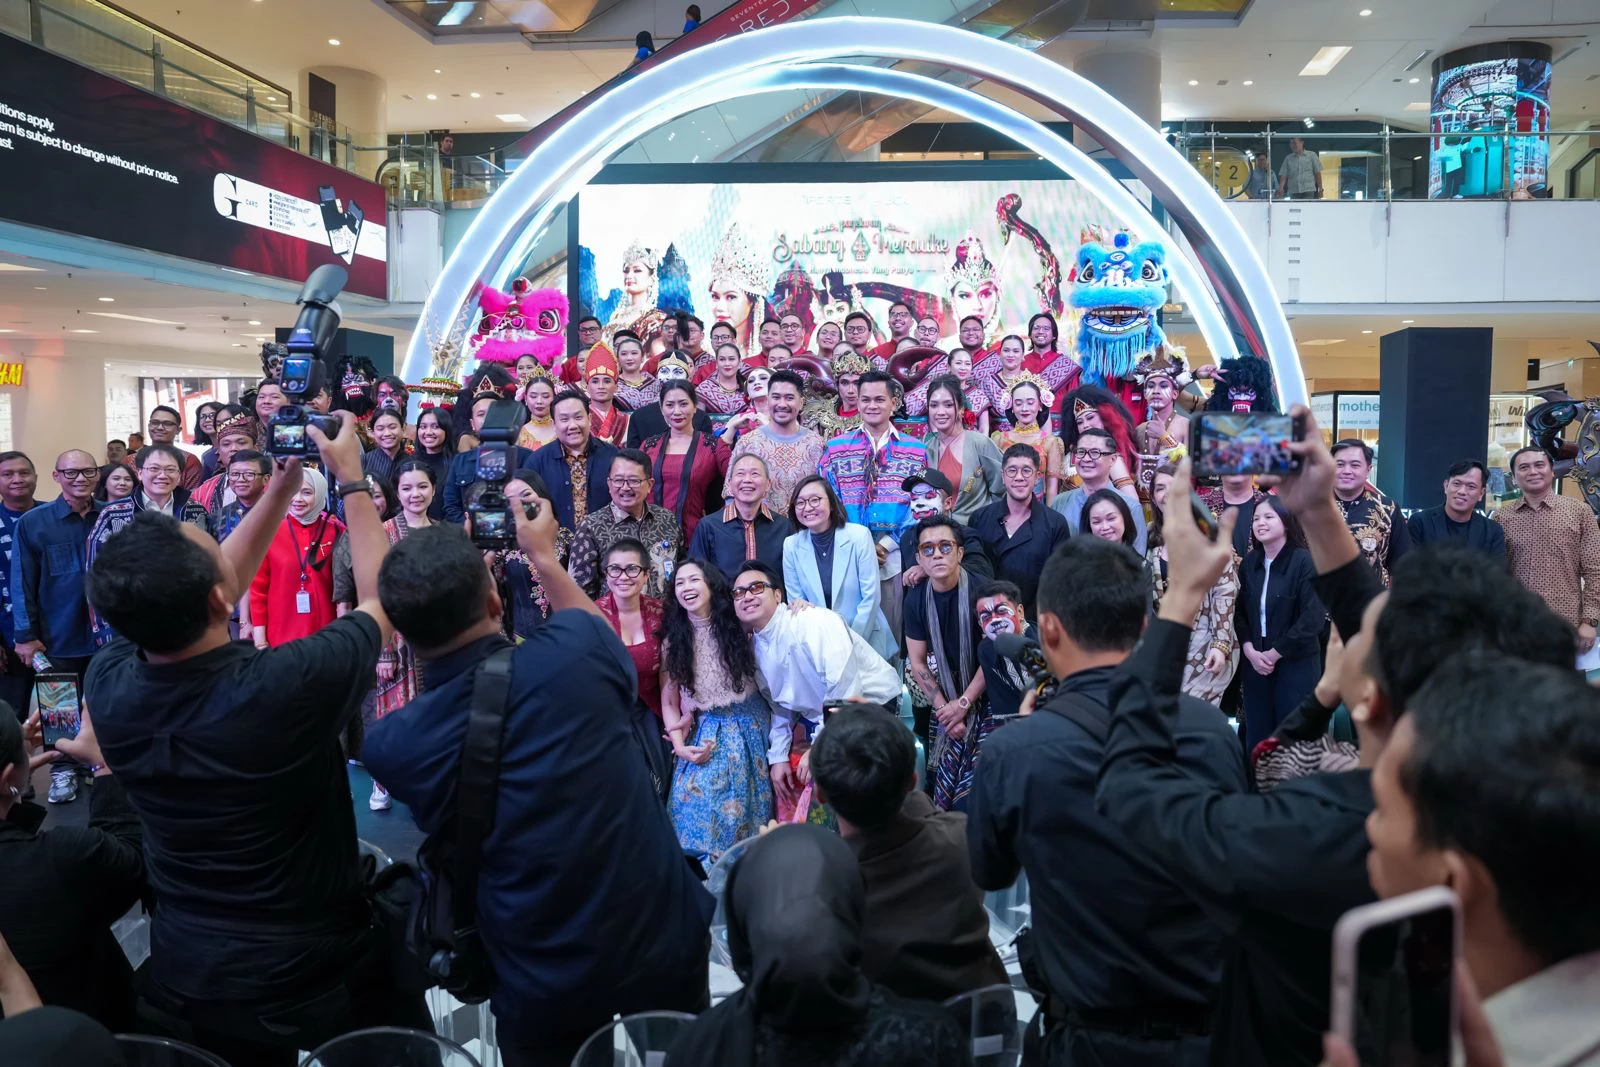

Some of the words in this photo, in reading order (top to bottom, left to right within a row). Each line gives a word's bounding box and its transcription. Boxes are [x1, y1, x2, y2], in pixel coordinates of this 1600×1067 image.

[27, 114, 55, 132] apply.
[16, 124, 25, 137] is
[26, 130, 61, 148] subject
[62, 140, 72, 151] to
[73, 144, 105, 163] change
[105, 154, 136, 172] without
[136, 164, 155, 177] prior
[155, 169, 179, 184] notice.
[1229, 165, 1238, 180] 2
[773, 233, 846, 263] Sabang
